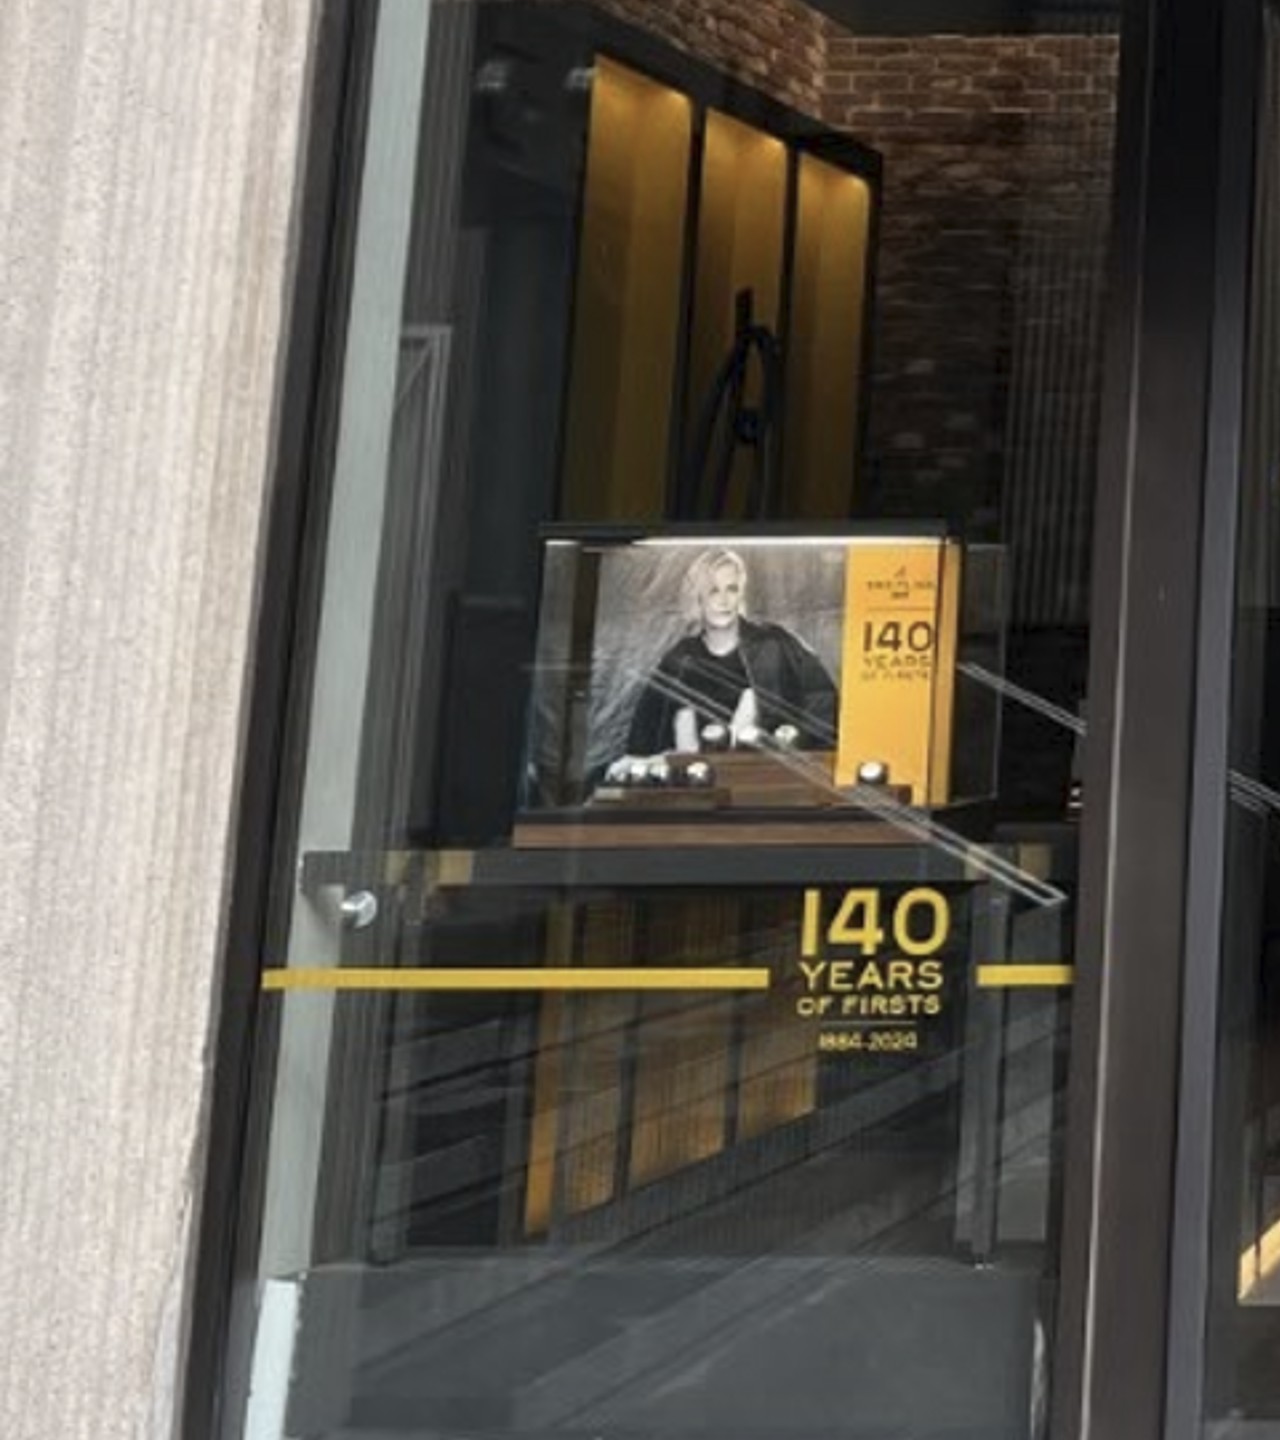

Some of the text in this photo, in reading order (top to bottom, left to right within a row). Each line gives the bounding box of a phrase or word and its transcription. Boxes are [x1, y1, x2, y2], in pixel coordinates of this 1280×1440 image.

[863, 621, 933, 652] 140
[801, 887, 950, 956] 140
[798, 961, 943, 990] YEARS
[797, 994, 941, 1016] OF FIRSTS
